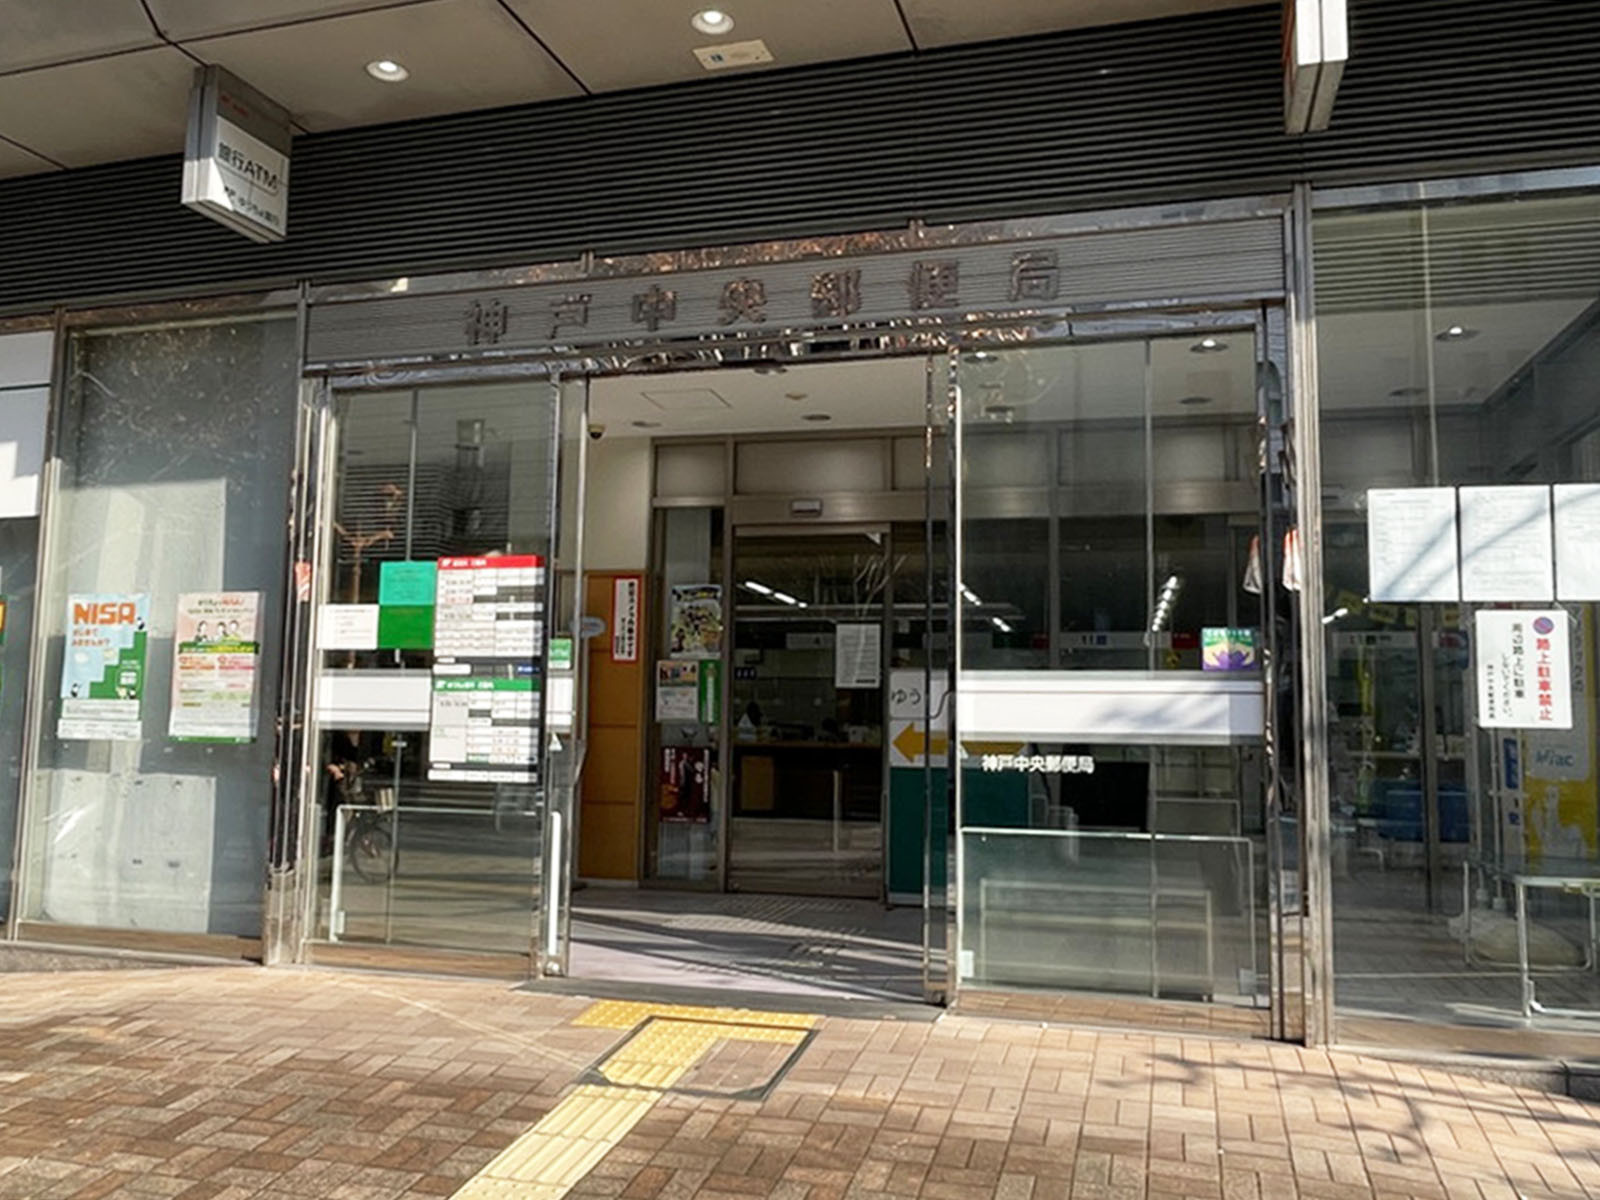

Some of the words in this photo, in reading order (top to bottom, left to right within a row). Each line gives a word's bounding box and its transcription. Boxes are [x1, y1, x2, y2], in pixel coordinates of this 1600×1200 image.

[462, 249, 1060, 346] 神戸中央郵便局
[74, 602, 136, 625] NISA
[1535, 637, 1553, 721] 路上駐車禁止
[981, 753, 1095, 775] 神戸中央郵便局
